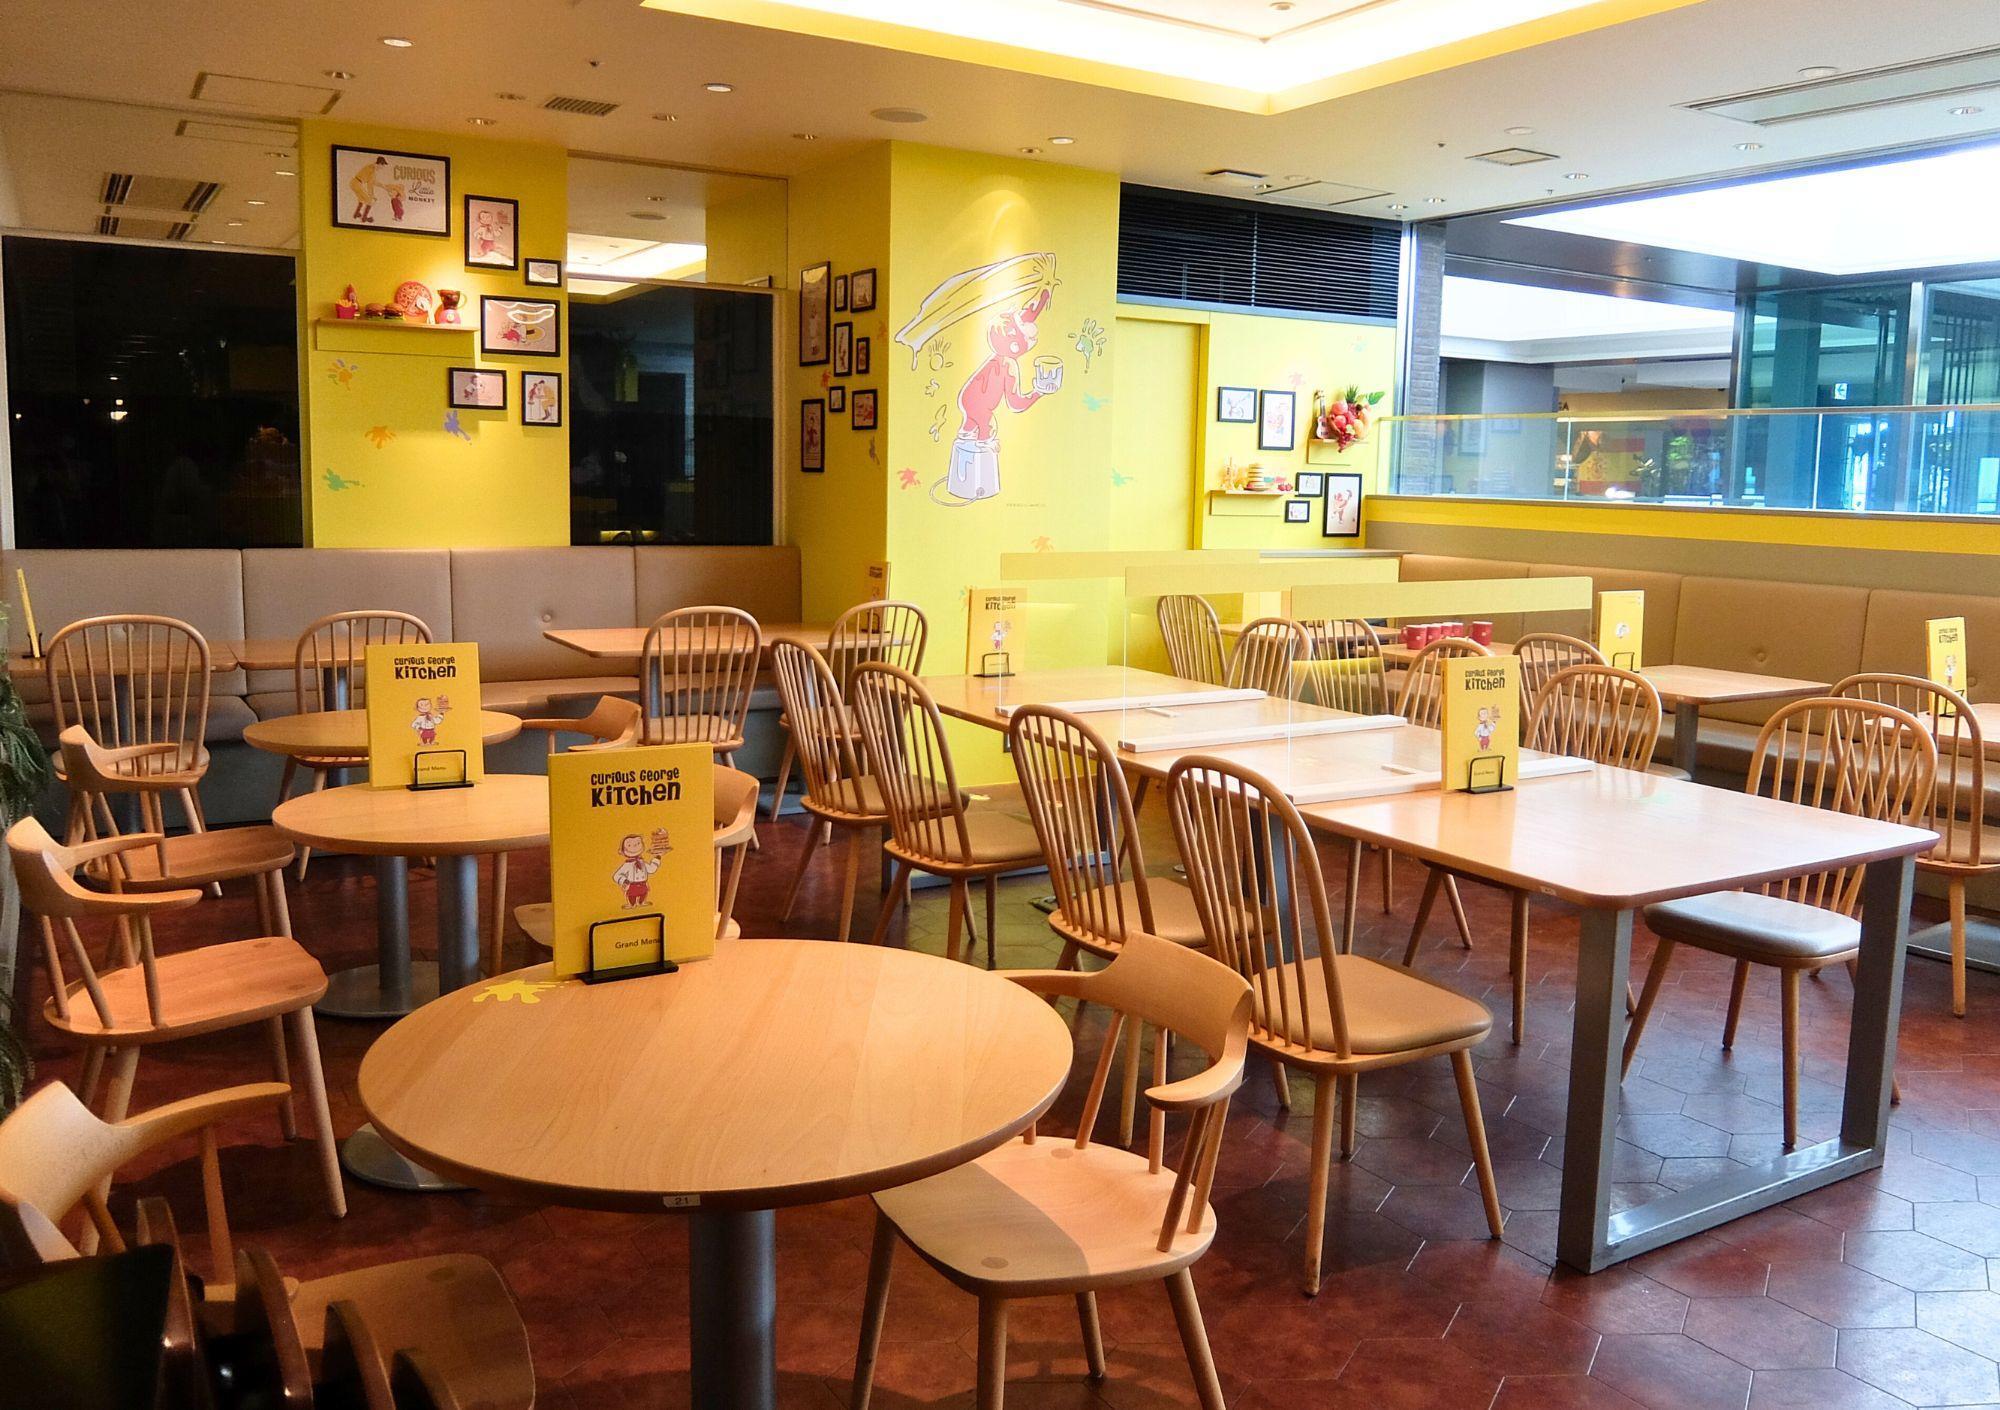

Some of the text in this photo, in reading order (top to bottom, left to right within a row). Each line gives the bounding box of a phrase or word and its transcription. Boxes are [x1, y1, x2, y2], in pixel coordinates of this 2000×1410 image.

[393, 165, 436, 185] CURIOUS
[615, 939, 639, 949] Grand
[674, 1197, 689, 1206] 21
